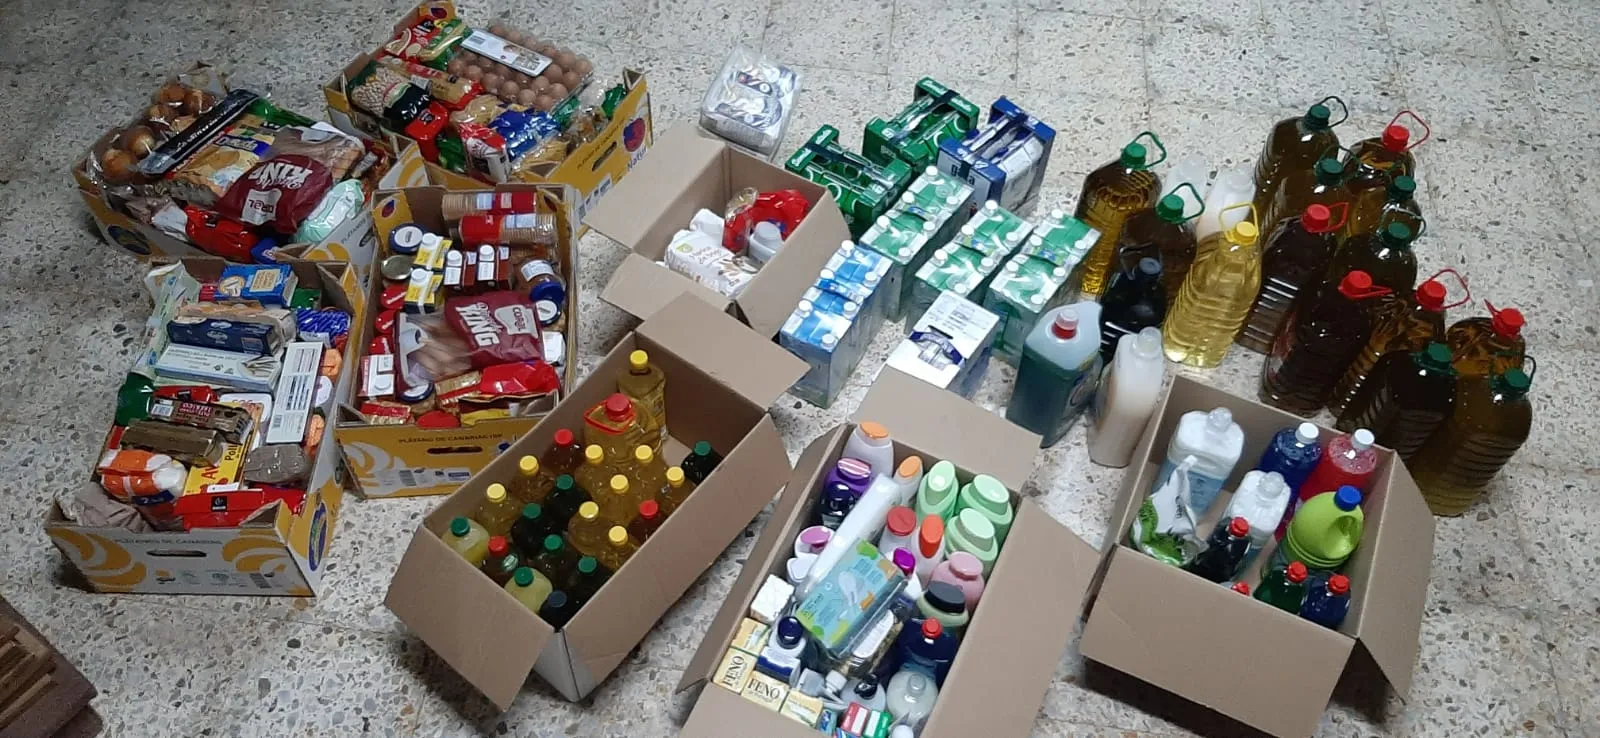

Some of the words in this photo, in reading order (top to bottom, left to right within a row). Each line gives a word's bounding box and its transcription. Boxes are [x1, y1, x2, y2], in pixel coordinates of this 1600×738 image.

[455, 303, 500, 347] KING
[722, 656, 744, 687] FENO
[748, 679, 780, 699] FENO
